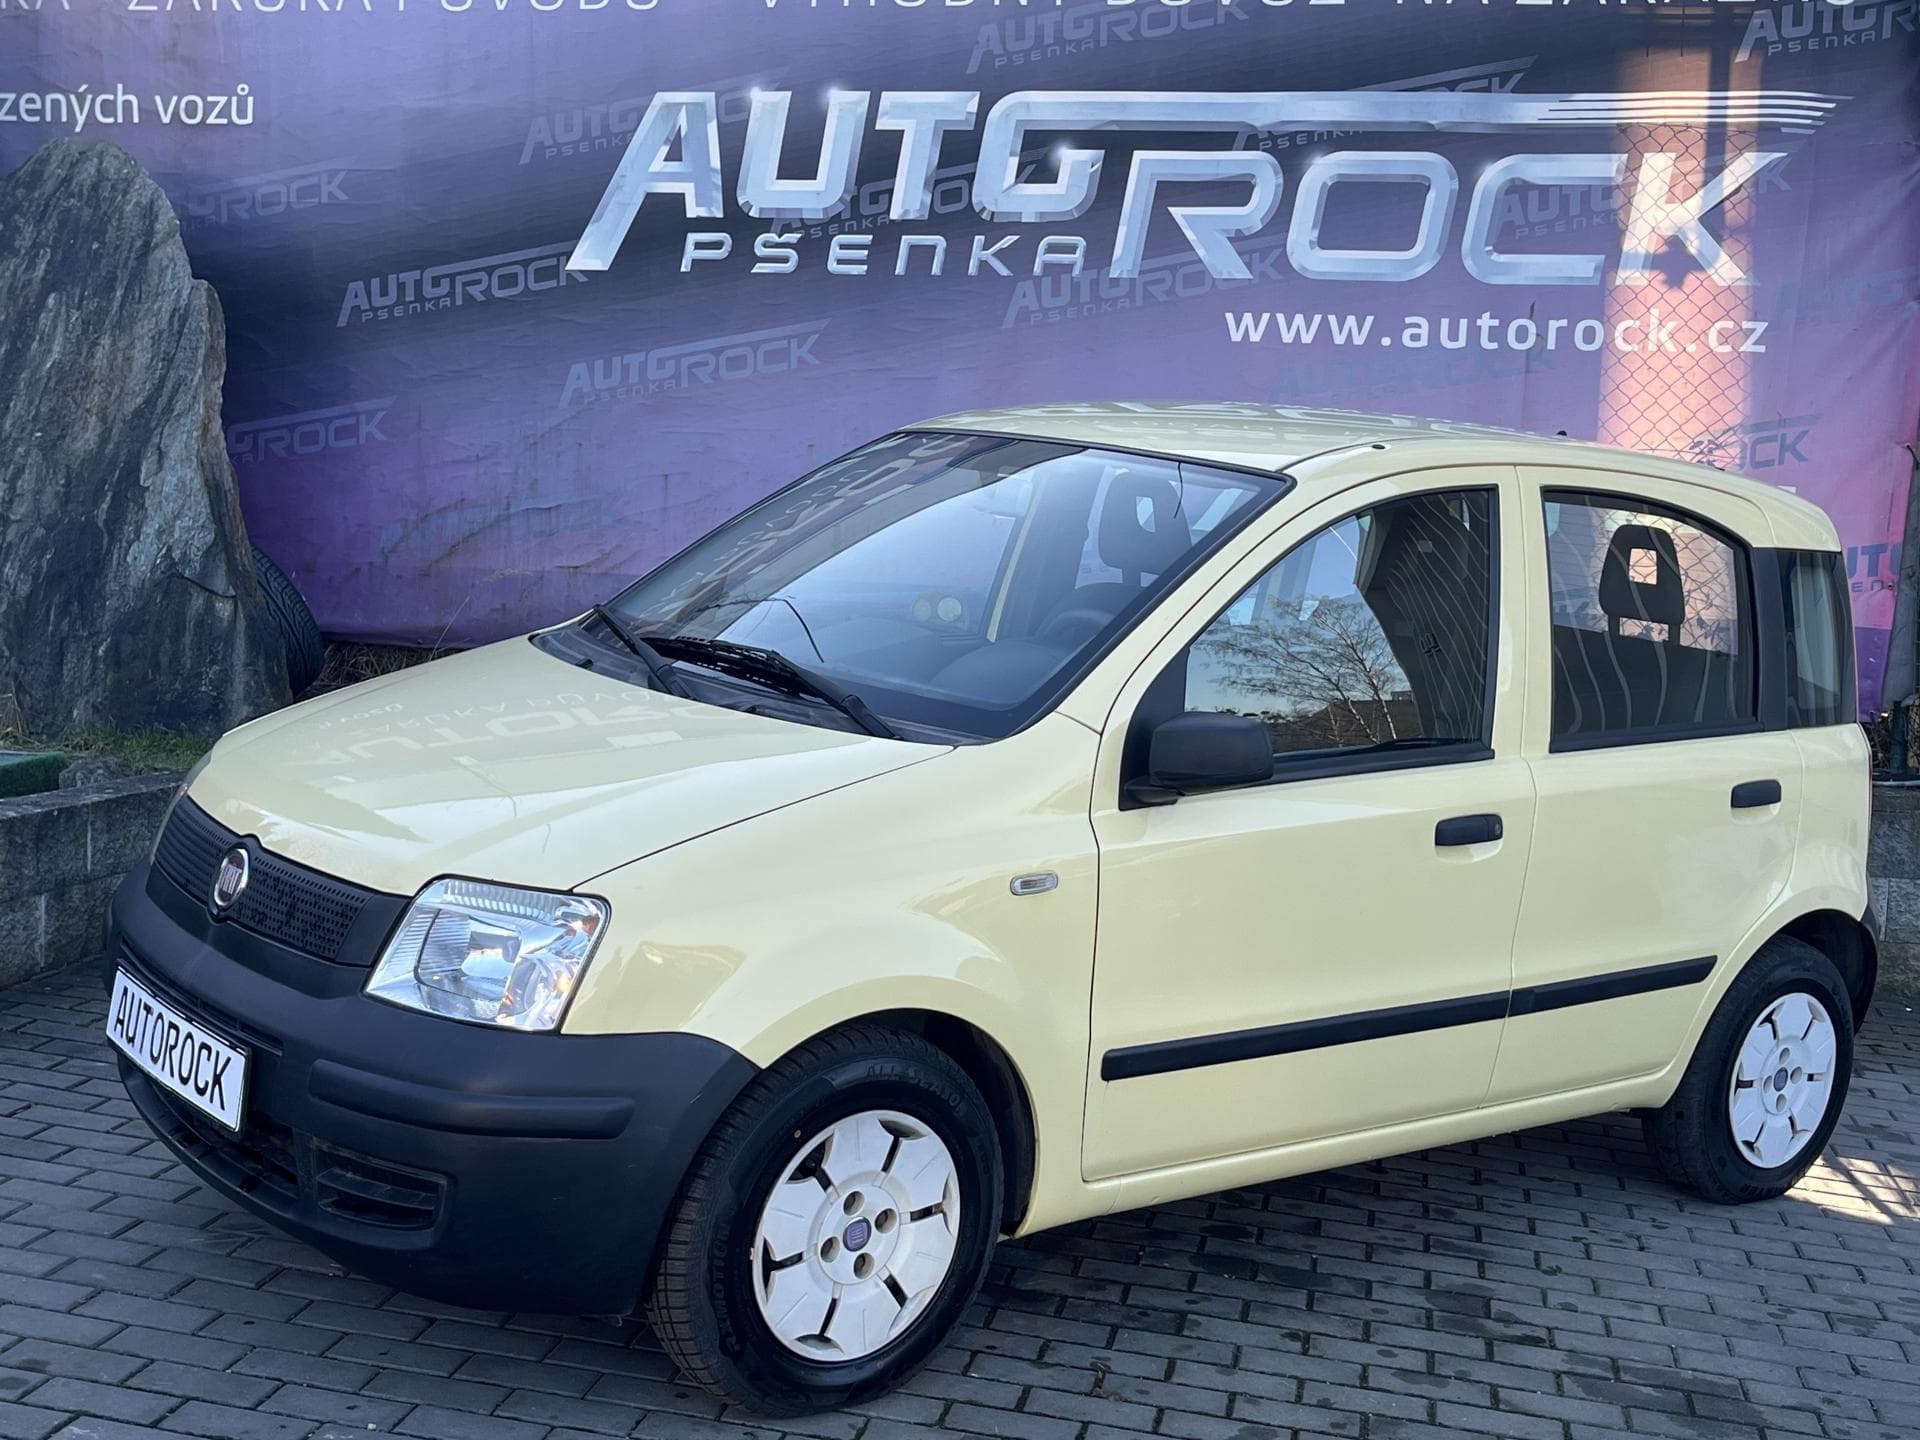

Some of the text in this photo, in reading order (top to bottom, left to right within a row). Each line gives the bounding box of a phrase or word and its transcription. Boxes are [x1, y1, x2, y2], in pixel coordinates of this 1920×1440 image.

[0, 83, 254, 133] zených vozů
[1225, 309, 1769, 353] www.autorock.cz
[113, 985, 233, 1112] AUTOROCK
